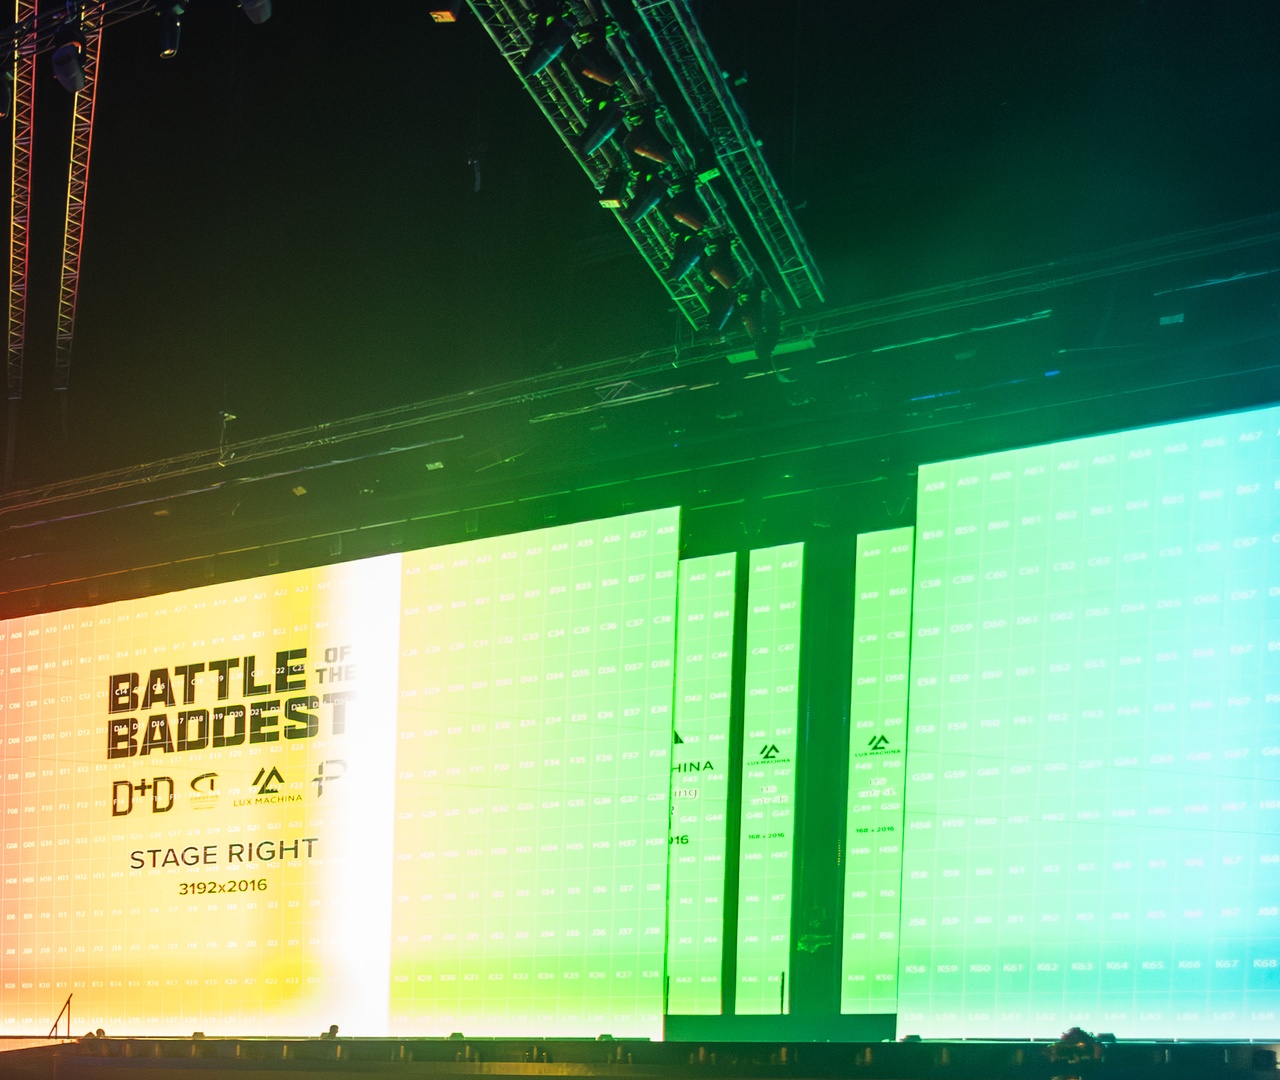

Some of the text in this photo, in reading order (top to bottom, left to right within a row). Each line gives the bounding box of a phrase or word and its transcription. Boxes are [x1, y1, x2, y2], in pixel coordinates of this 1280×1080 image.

[108, 645, 352, 714] BATTLE OF
[315, 664, 356, 684] THE
[108, 690, 357, 759] BADDEST
[255, 795, 302, 805] MACHINA
[130, 838, 318, 870] STAGE RIGHT
[178, 878, 268, 895] 3192x2016
